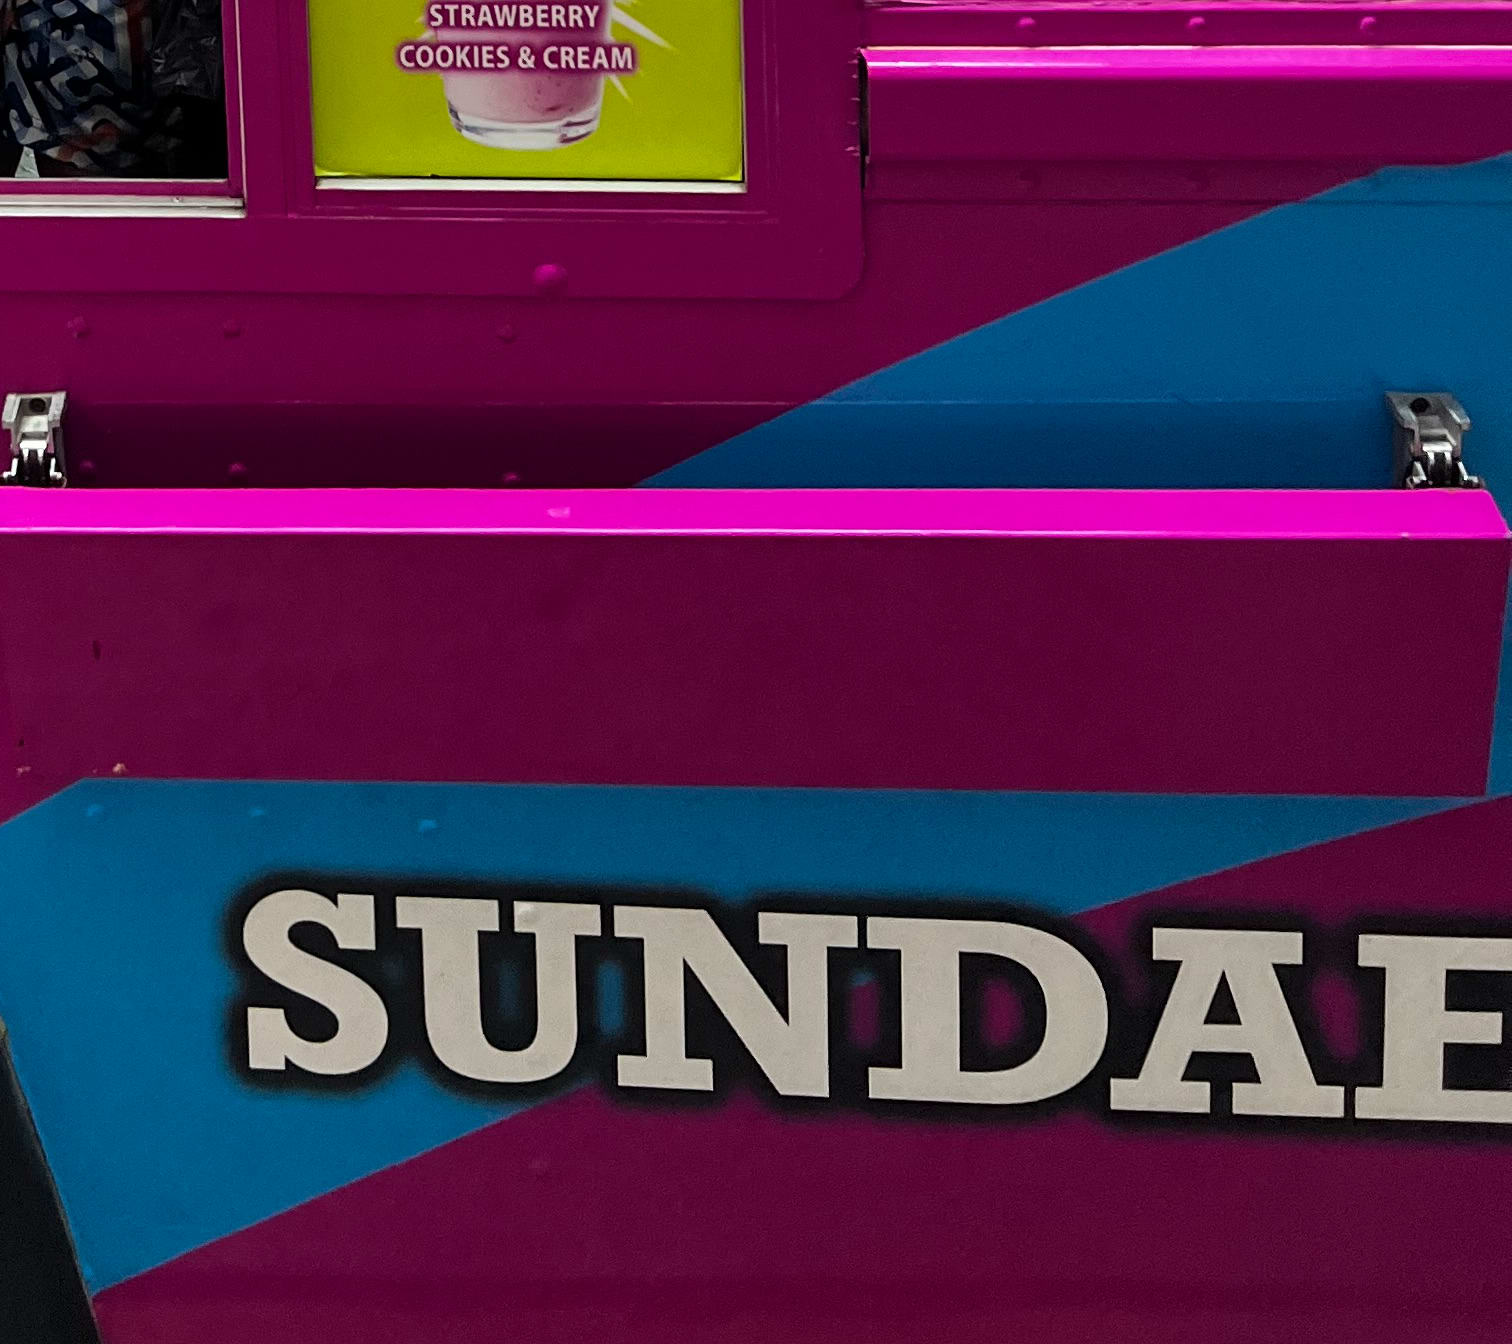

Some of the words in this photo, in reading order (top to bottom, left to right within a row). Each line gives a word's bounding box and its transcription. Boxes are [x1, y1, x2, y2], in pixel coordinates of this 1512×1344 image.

[429, 4, 599, 28] STRAWBERRY
[399, 44, 509, 69] COOKIES
[517, 46, 535, 69] &
[543, 46, 633, 70] CREAM
[242, 889, 1512, 1124] SUNDAE
